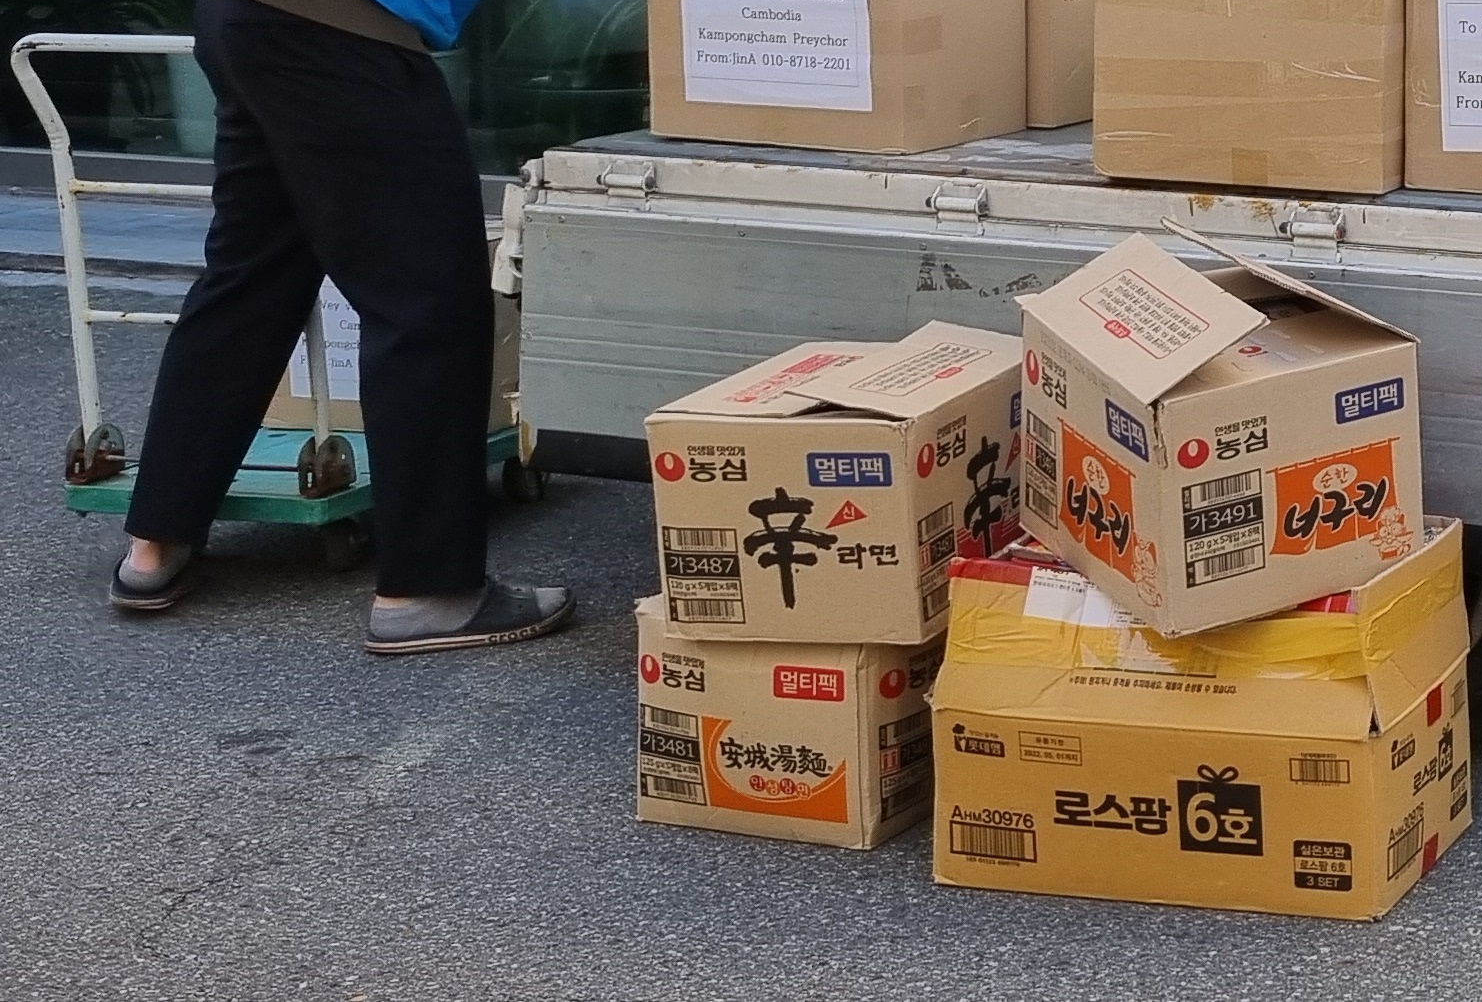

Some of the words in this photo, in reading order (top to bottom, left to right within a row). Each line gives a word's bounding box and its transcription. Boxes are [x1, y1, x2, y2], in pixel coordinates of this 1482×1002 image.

[741, 6, 802, 22] Cambodia
[1458, 20, 1477, 34] To
[698, 27, 787, 45] Kampongcham
[793, 33, 849, 48] Preychor
[696, 50, 757, 65] From:JinA
[762, 54, 851, 71] 010-8718-2201
[1041, 366, 1067, 410] 농심
[1341, 382, 1398, 418] 멀티팩
[1108, 408, 1145, 456] 멀티팩
[1215, 427, 1269, 460] 농심
[936, 428, 967, 468] 농심
[688, 458, 748, 483] 농심
[814, 457, 885, 484] 멀티팩
[1320, 467, 1349, 489] 순한
[842, 506, 856, 520] 신
[1067, 478, 1130, 555] 너구리
[1189, 501, 1257, 533] 가3491
[1283, 476, 1389, 538] 너구리
[744, 487, 838, 610] 辛
[837, 542, 900, 568] 라면
[669, 556, 734, 574] 가3487
[661, 663, 706, 693] 농심
[780, 670, 838, 698] 멀티팩
[642, 732, 696, 758] 가3481
[951, 804, 1035, 829] AHM30976
[1053, 789, 1172, 836] 로스팜
[1186, 792, 1258, 845] 6호
[1300, 844, 1346, 859] 실온보관
[1330, 861, 1347, 873] 6호
[1306, 875, 1315, 888] 3
[1317, 876, 1340, 888] SET
